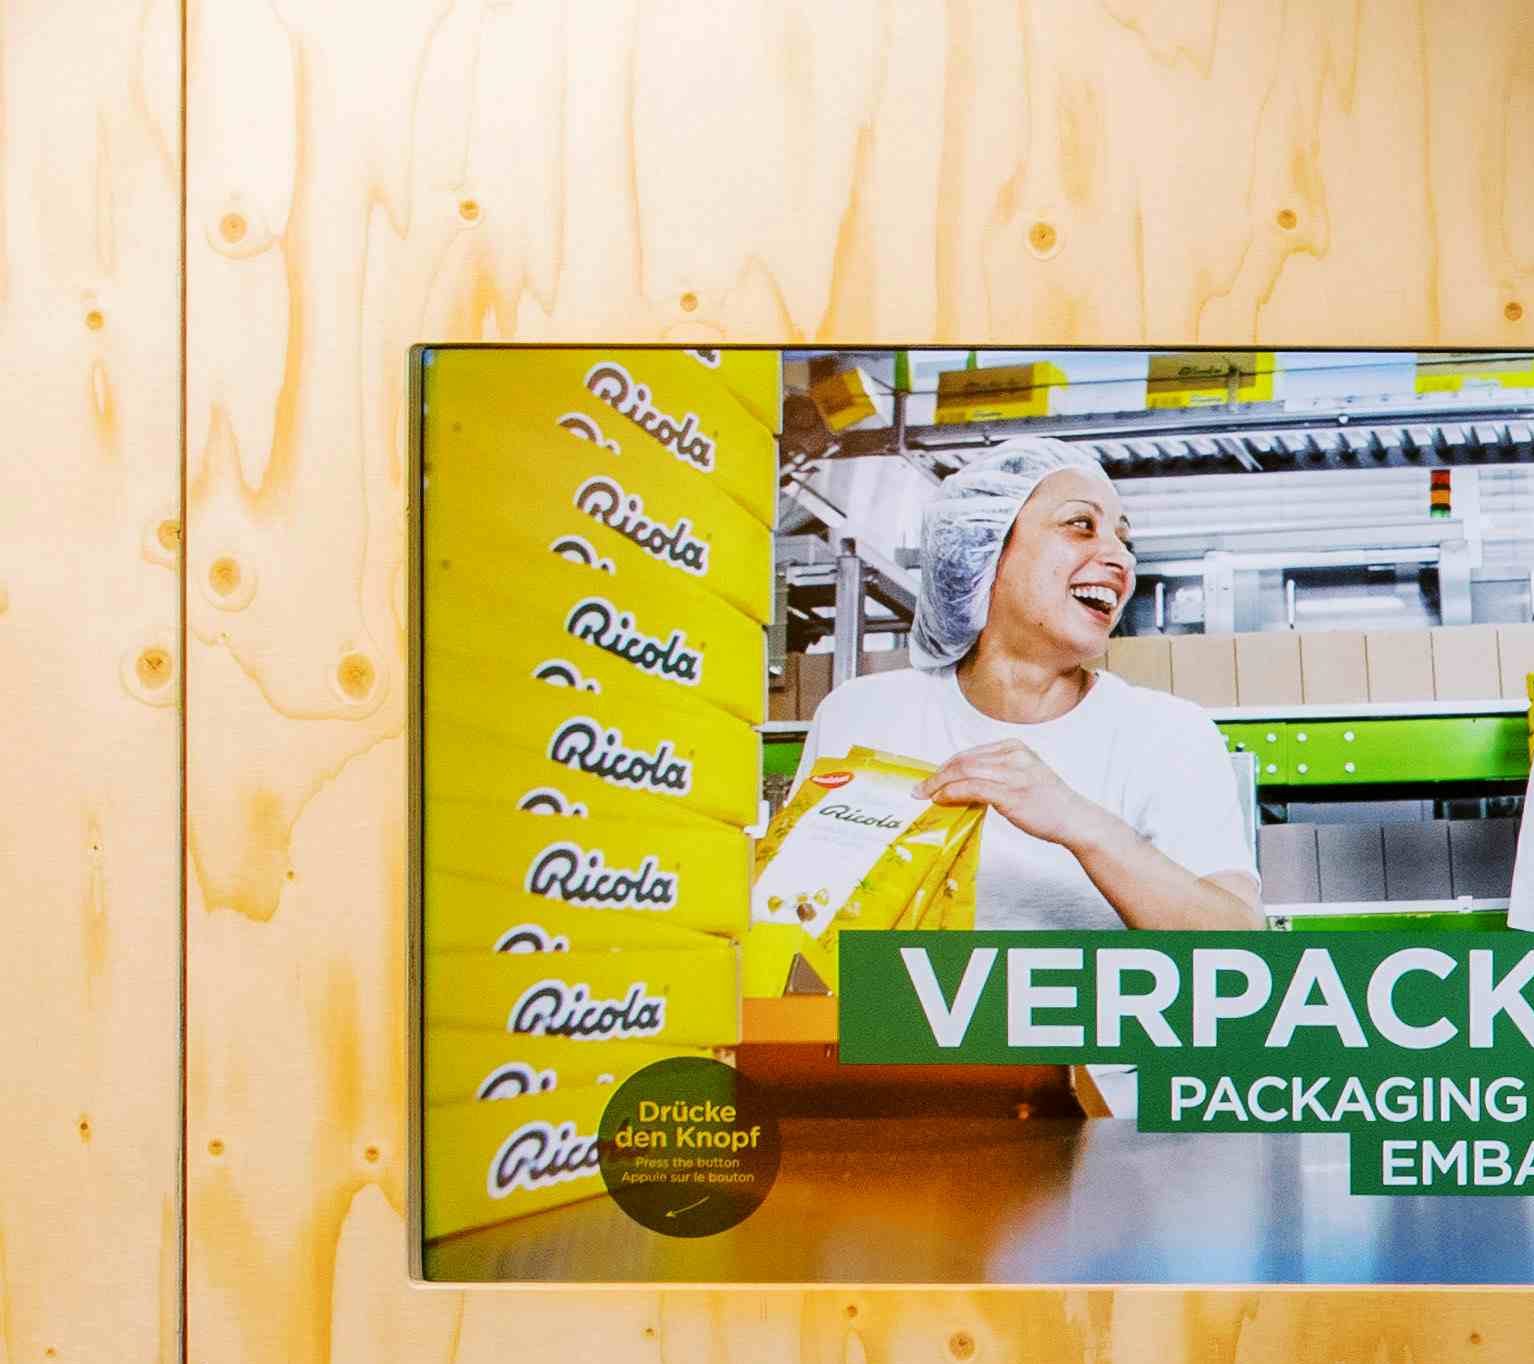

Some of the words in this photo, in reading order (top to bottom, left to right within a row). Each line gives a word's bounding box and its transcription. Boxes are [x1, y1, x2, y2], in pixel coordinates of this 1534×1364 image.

[586, 367, 711, 467] Ricola
[577, 482, 703, 571] Ricola
[568, 603, 696, 680] Ricola
[551, 723, 686, 789] Ricola
[530, 849, 674, 903] Ricola
[513, 987, 662, 1037] Ricola
[639, 1100, 737, 1123] Drücke
[1170, 1076, 1529, 1124] PACKAGING
[497, 1129, 600, 1189] Rico
[615, 1126, 667, 1149] den
[676, 1126, 760, 1152] Knopf
[636, 1157, 669, 1169] Press
[673, 1157, 694, 1169] the
[698, 1157, 740, 1169] button
[671, 1173, 691, 1183] sur
[694, 1172, 706, 1183] le
[709, 1172, 754, 1183] bouton
